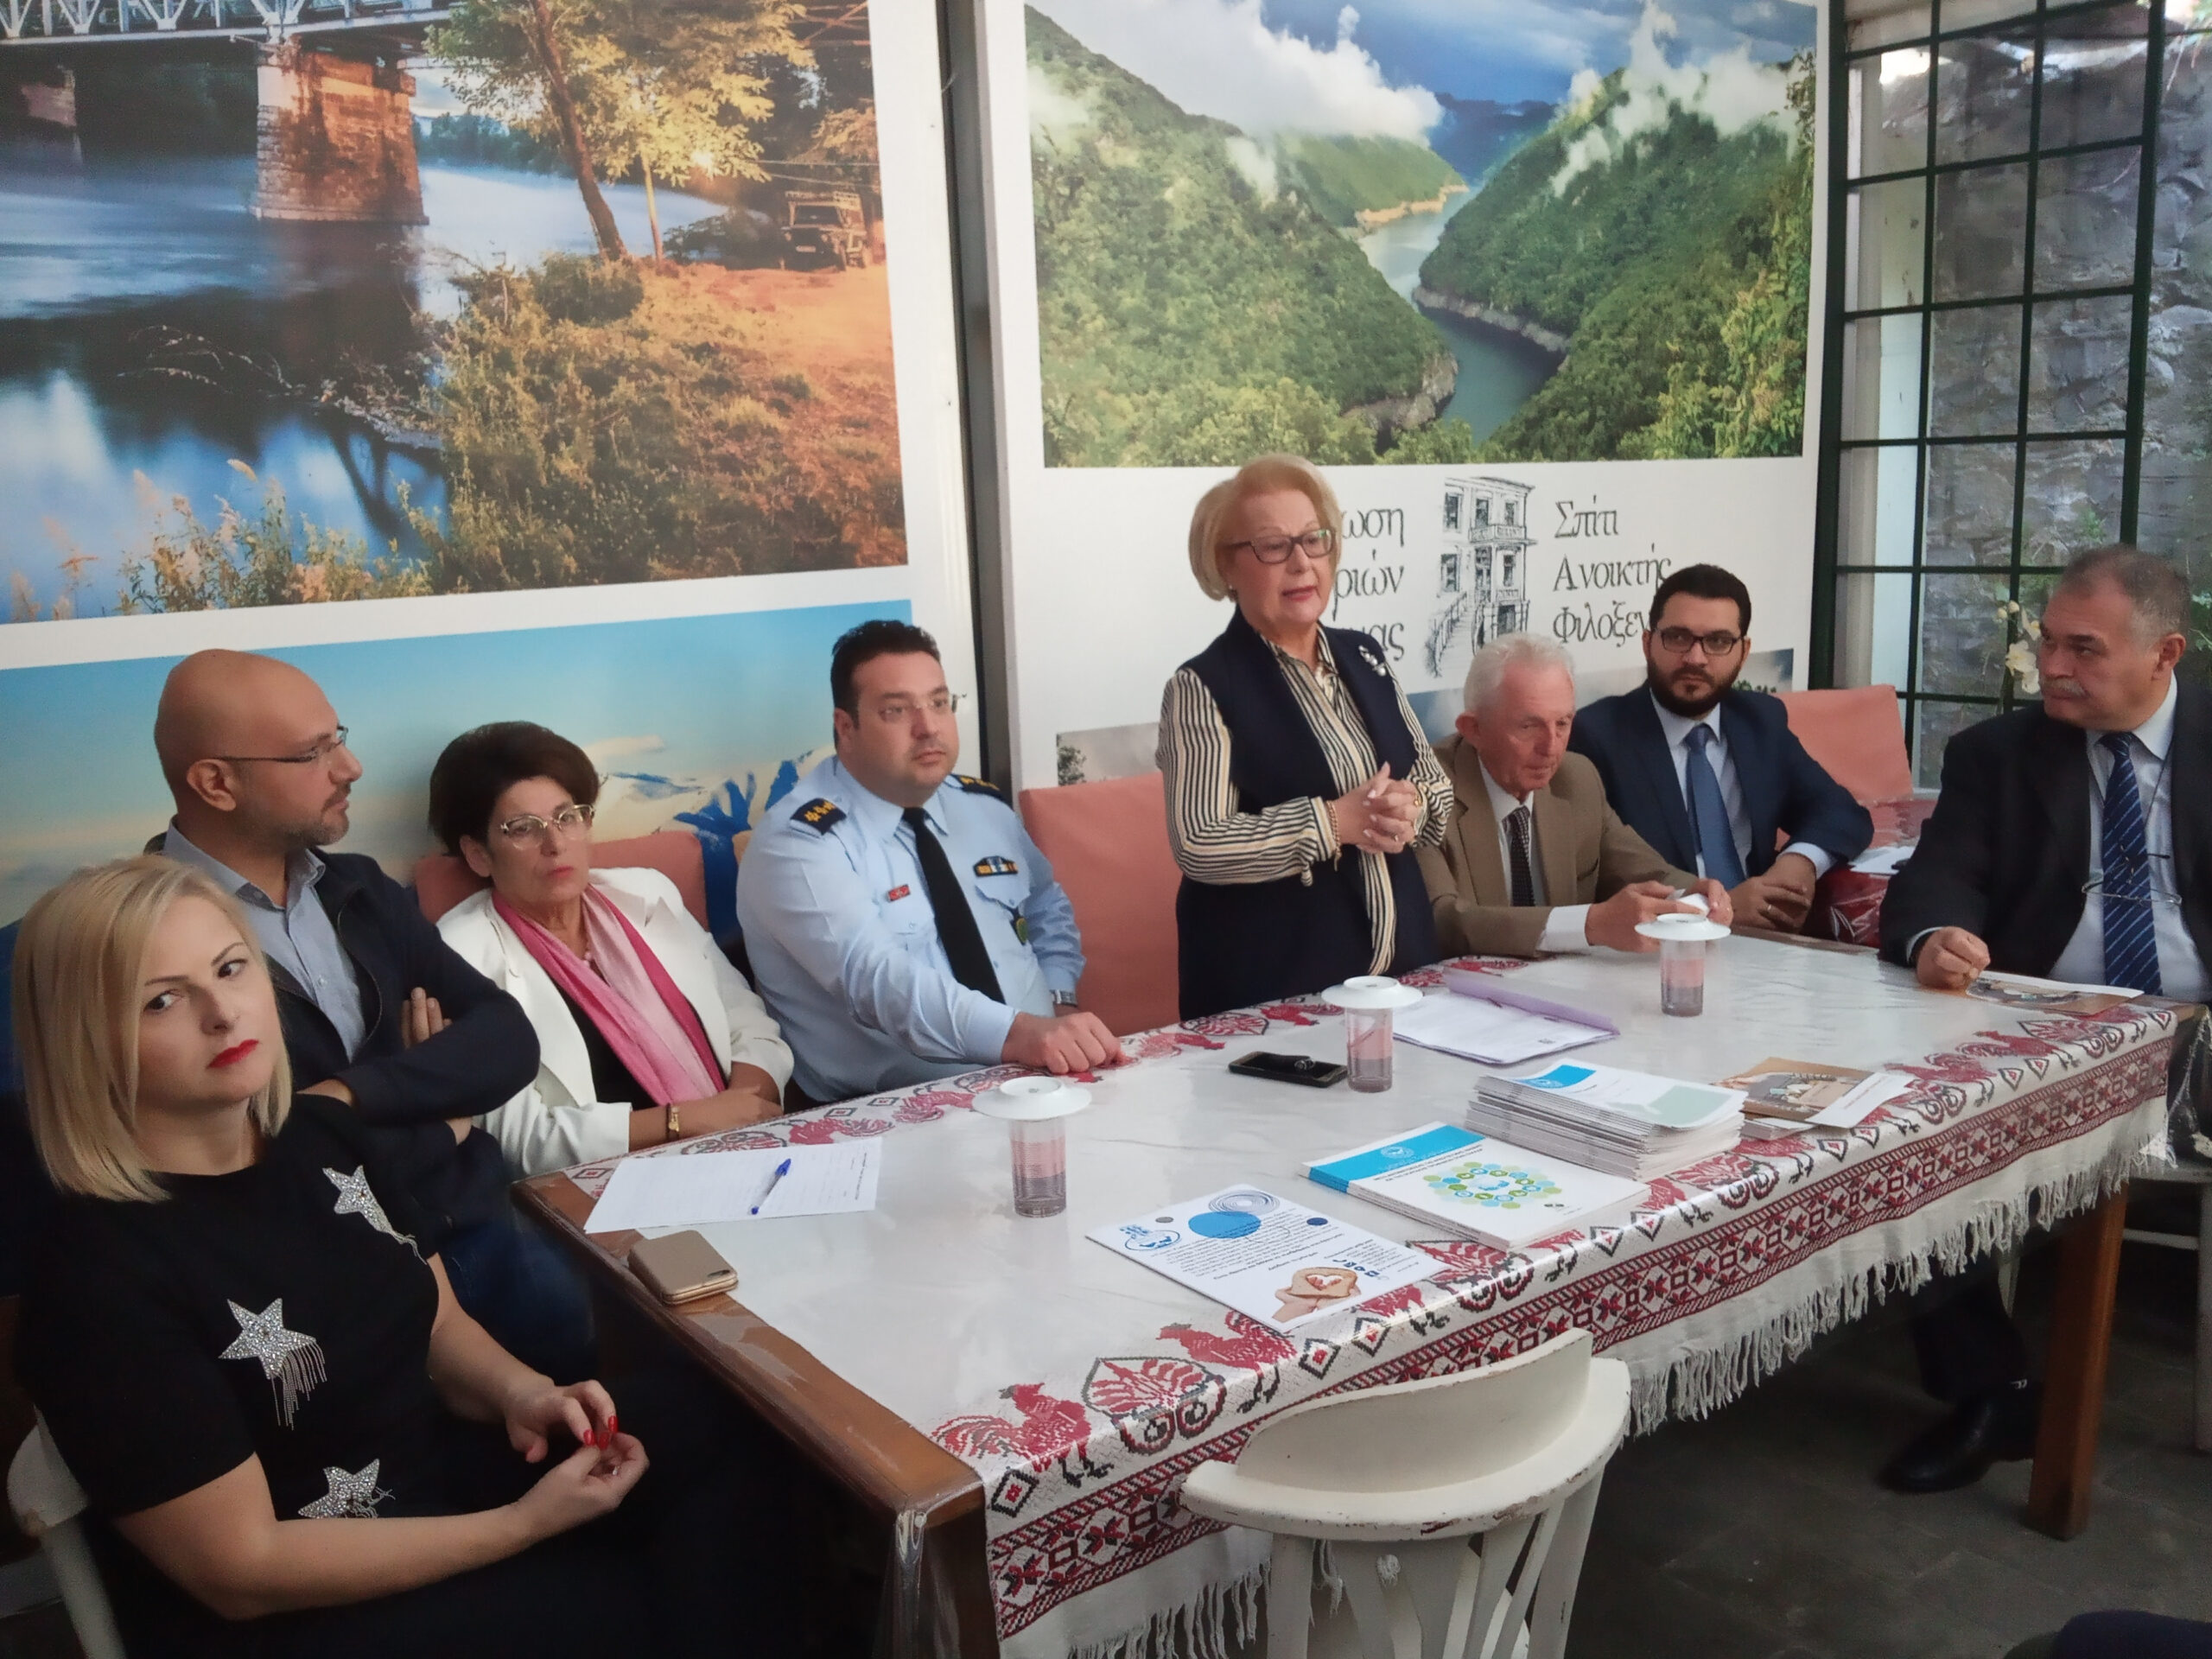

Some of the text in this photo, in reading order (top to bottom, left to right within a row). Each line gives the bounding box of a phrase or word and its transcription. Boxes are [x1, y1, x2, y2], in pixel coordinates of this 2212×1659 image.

[1342, 508, 1404, 547] ωση
[1554, 494, 1618, 538] Σπίτι
[1332, 549, 1404, 621] ριών
[1553, 543, 1672, 592] Ανοικτής
[1553, 600, 1650, 648] Φιλοξεν
